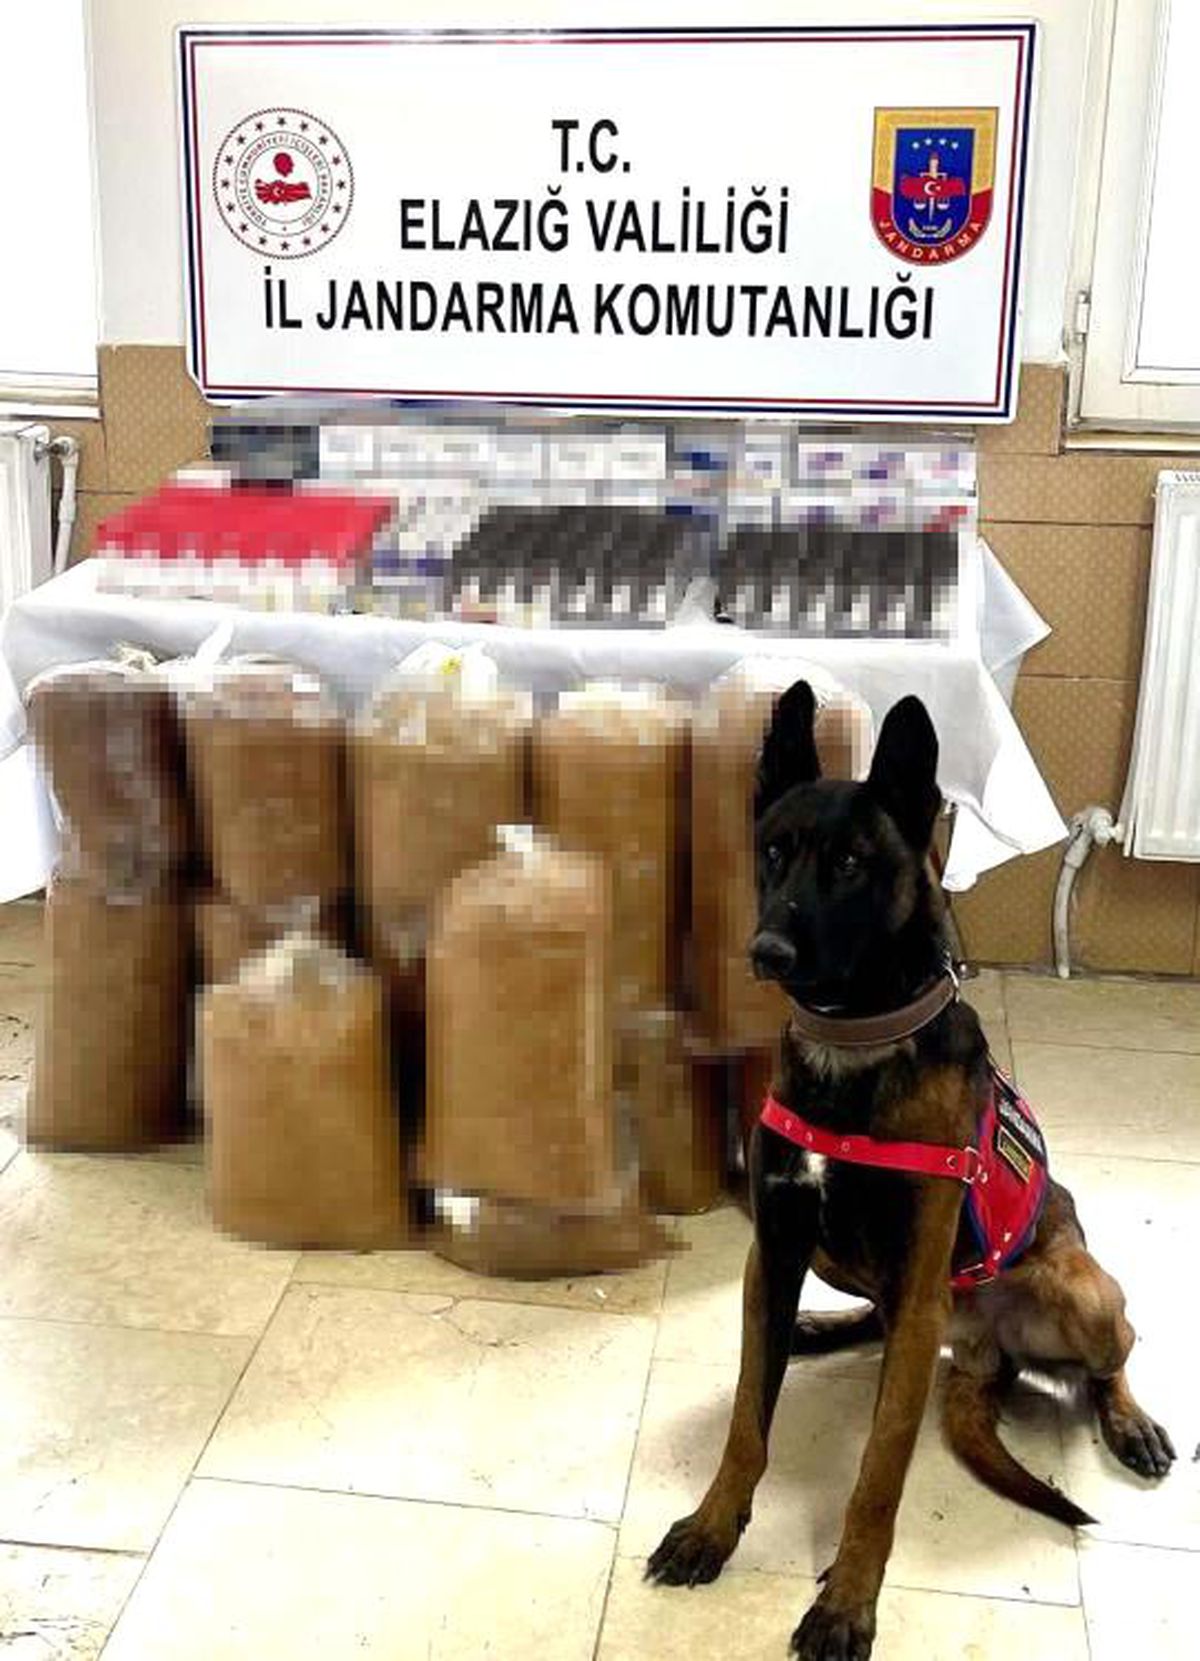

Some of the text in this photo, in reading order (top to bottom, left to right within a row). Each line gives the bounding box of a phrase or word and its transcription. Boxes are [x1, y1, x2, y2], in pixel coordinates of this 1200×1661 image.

[552, 119, 630, 173] T.C.
[401, 186, 788, 253] ELAZIĞ VALİLİĞİ
[879, 220, 982, 260] JANDARMA
[265, 266, 933, 339] İL JANDARMA KOMUTANLIĞI
